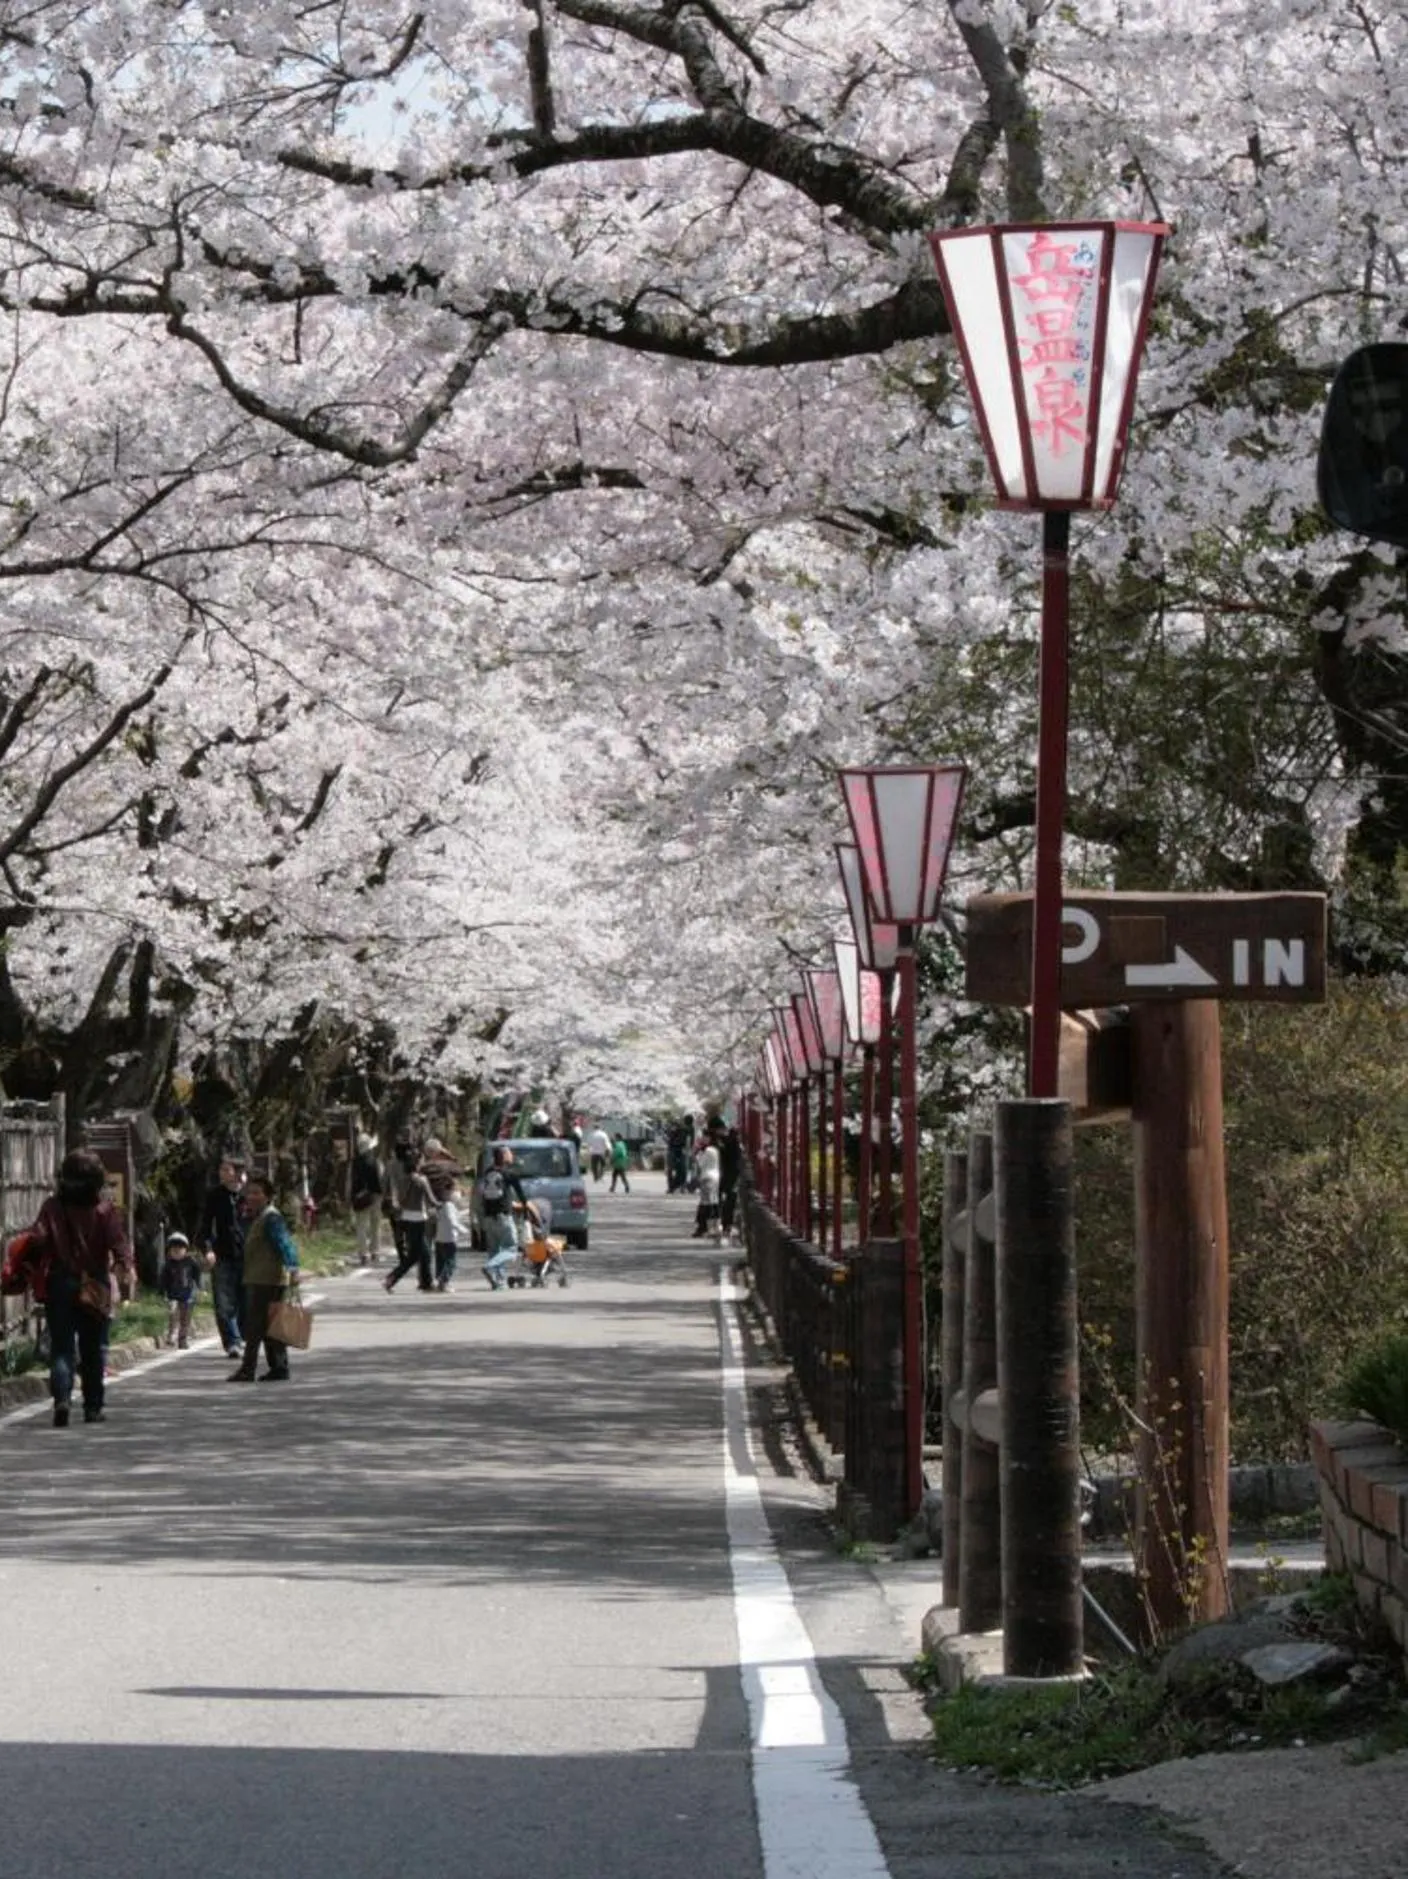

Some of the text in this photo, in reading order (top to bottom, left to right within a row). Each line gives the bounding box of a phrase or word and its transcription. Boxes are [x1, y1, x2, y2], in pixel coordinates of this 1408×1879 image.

[1013, 231, 1086, 458] 岳温泉
[1233, 939, 1305, 986] IN
